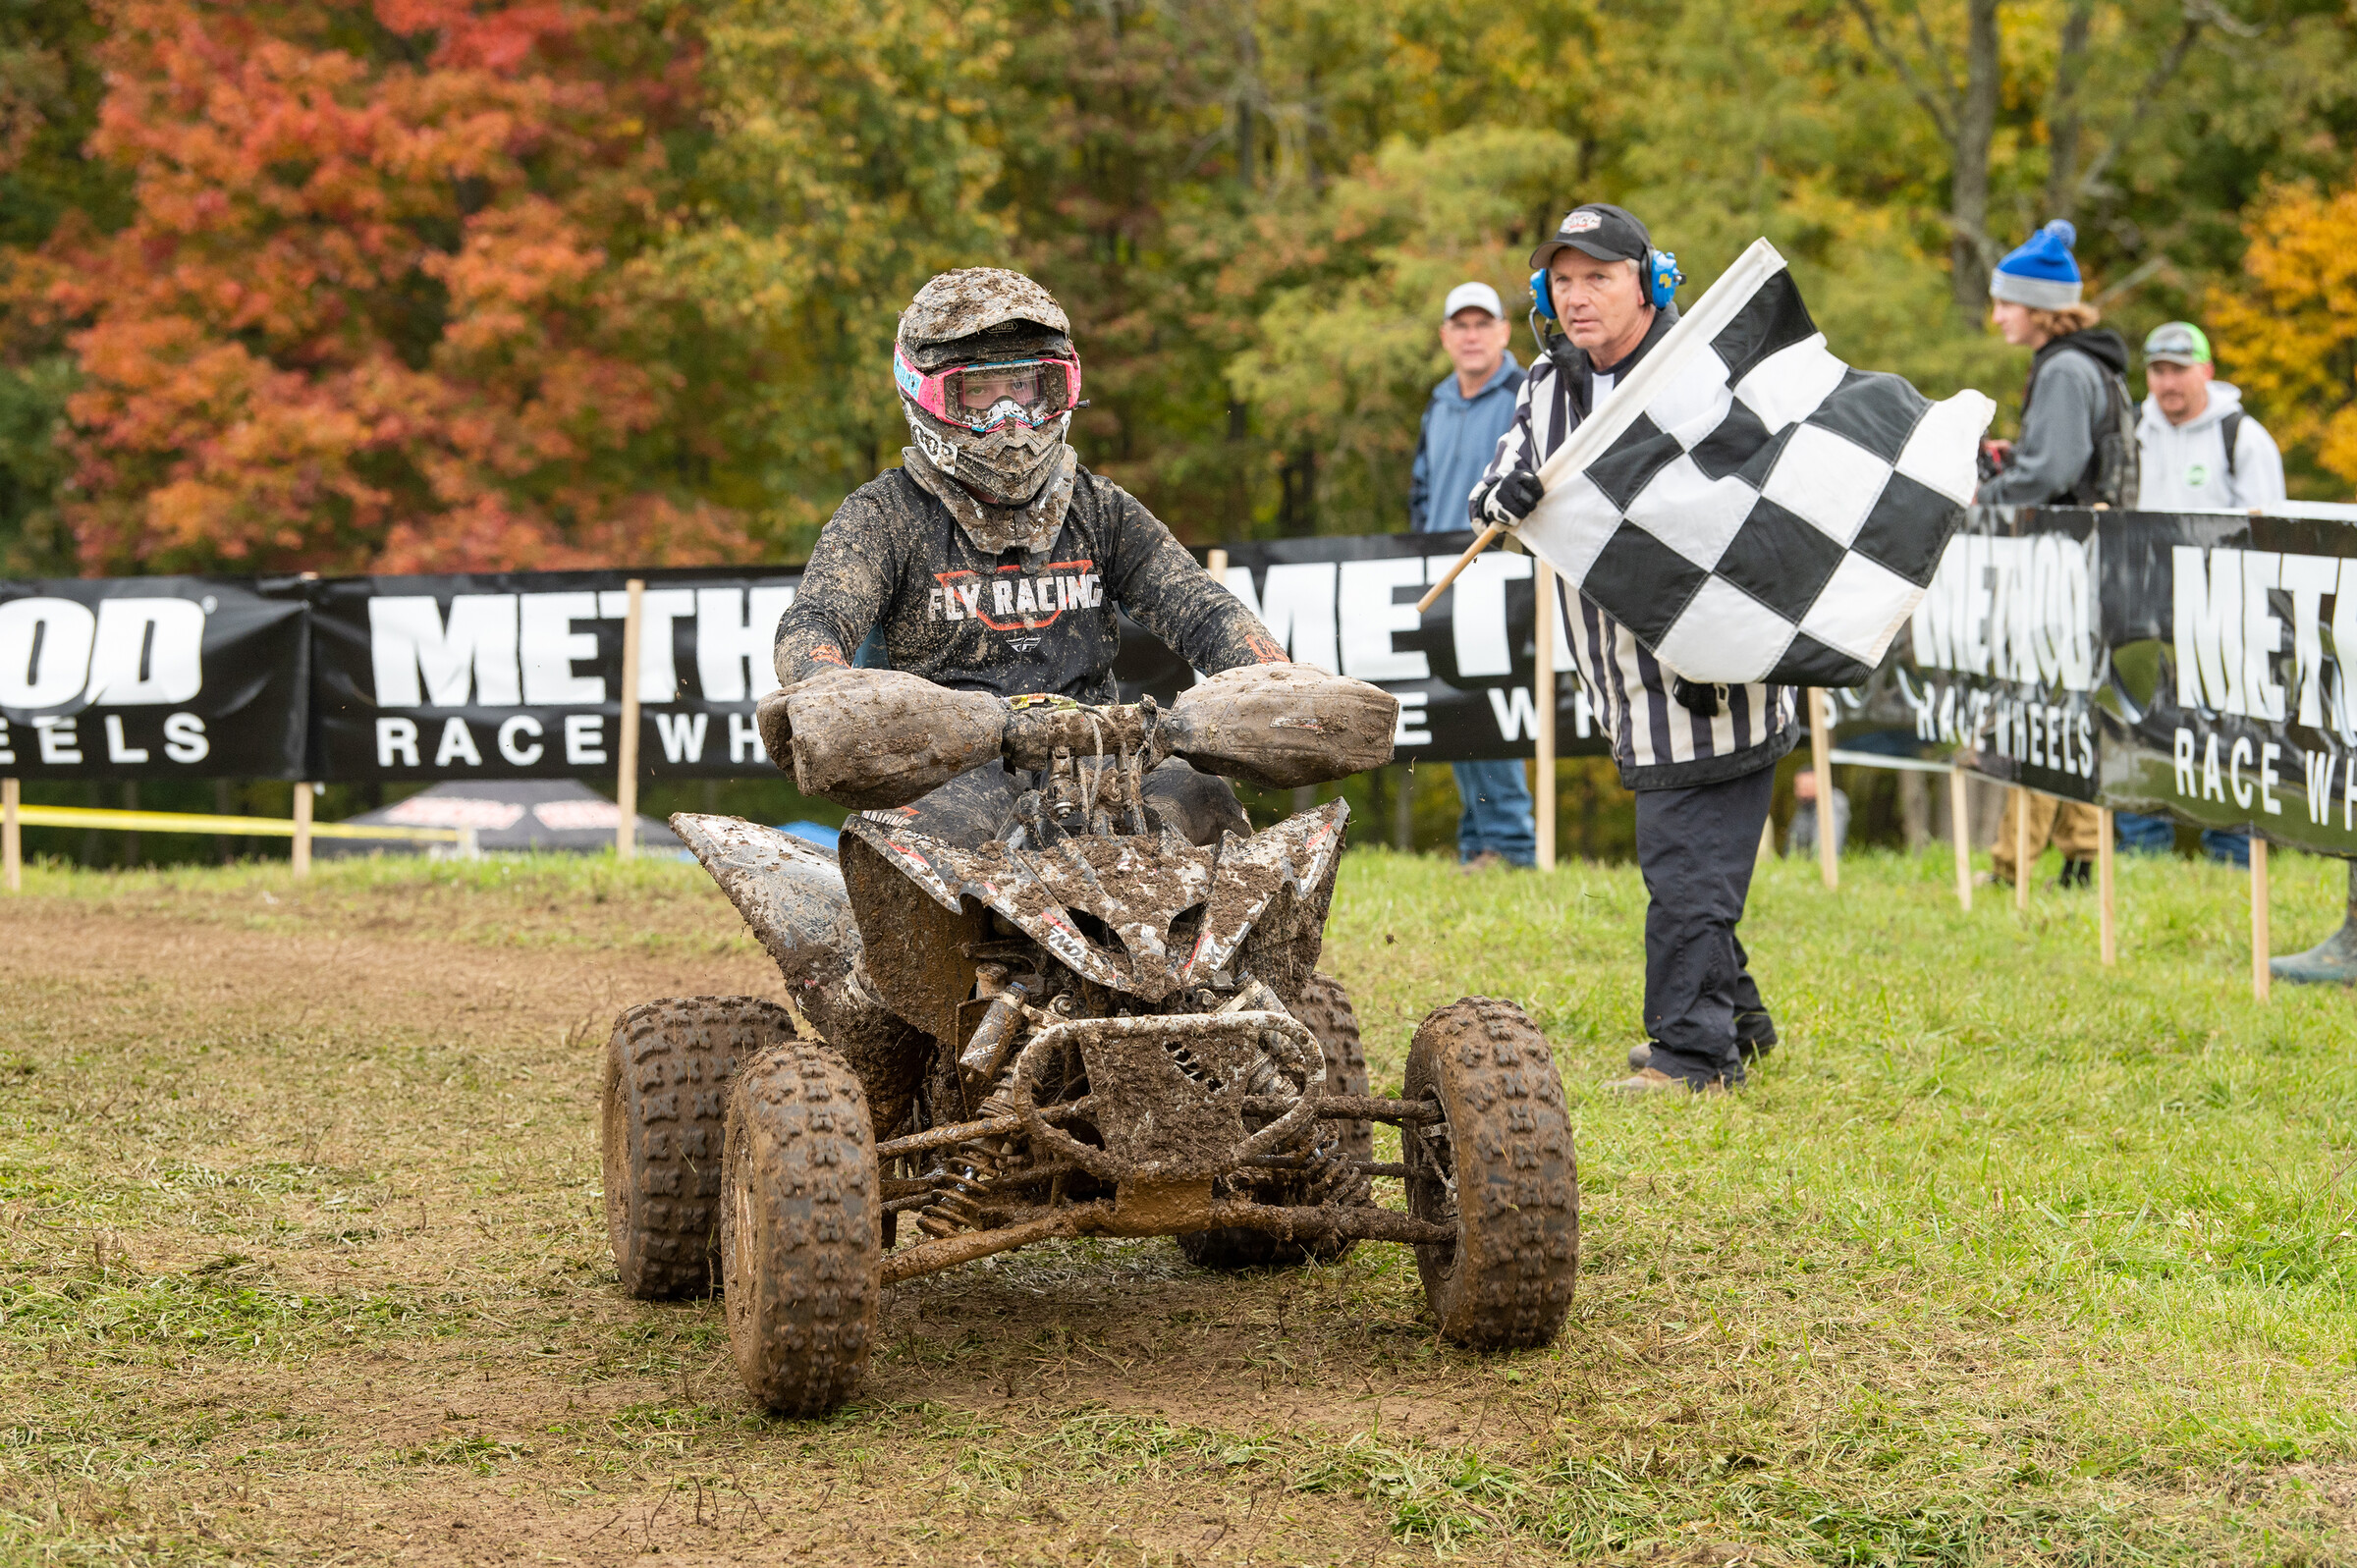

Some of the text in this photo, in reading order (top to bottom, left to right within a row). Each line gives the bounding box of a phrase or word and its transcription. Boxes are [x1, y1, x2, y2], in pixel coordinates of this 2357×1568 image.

[928, 573, 1103, 622] FLY RACING
[375, 714, 608, 768] RACE
[2173, 727, 2282, 816] RACE
